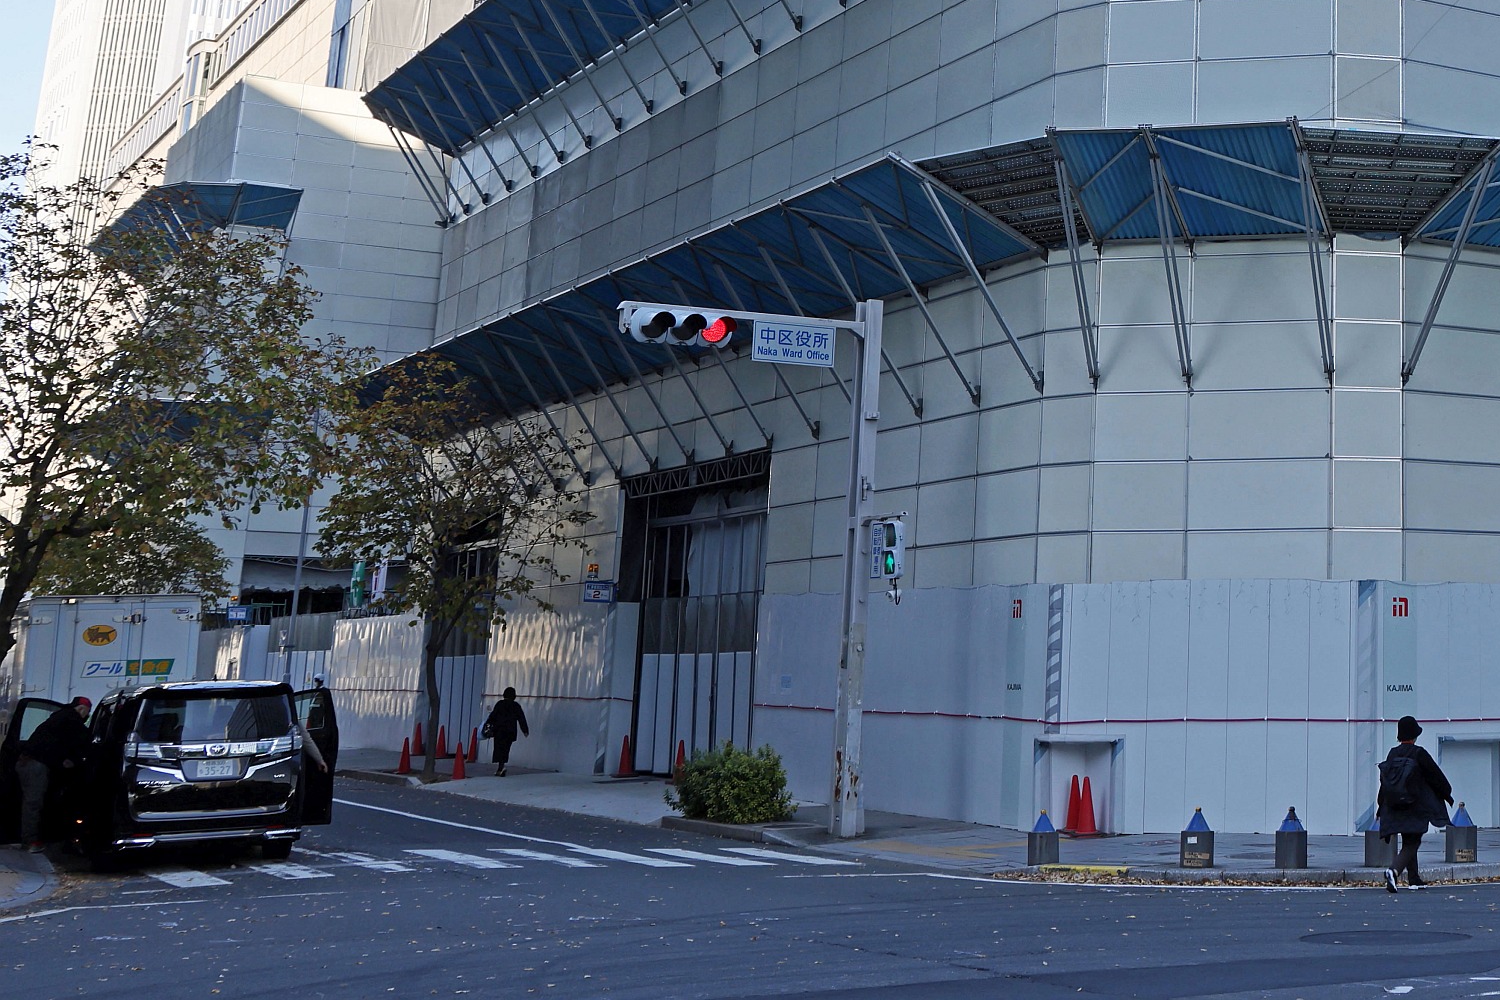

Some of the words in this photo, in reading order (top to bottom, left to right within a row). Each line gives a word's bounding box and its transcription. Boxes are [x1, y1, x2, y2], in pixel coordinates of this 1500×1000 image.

[760, 327, 829, 350] 中区役所
[757, 346, 778, 356] Naka
[782, 348, 803, 359] Ward
[806, 350, 830, 361] Office
[86, 662, 123, 676] クール
[1386, 684, 1413, 692] KAJIMA
[204, 765, 231, 776] 35-27
